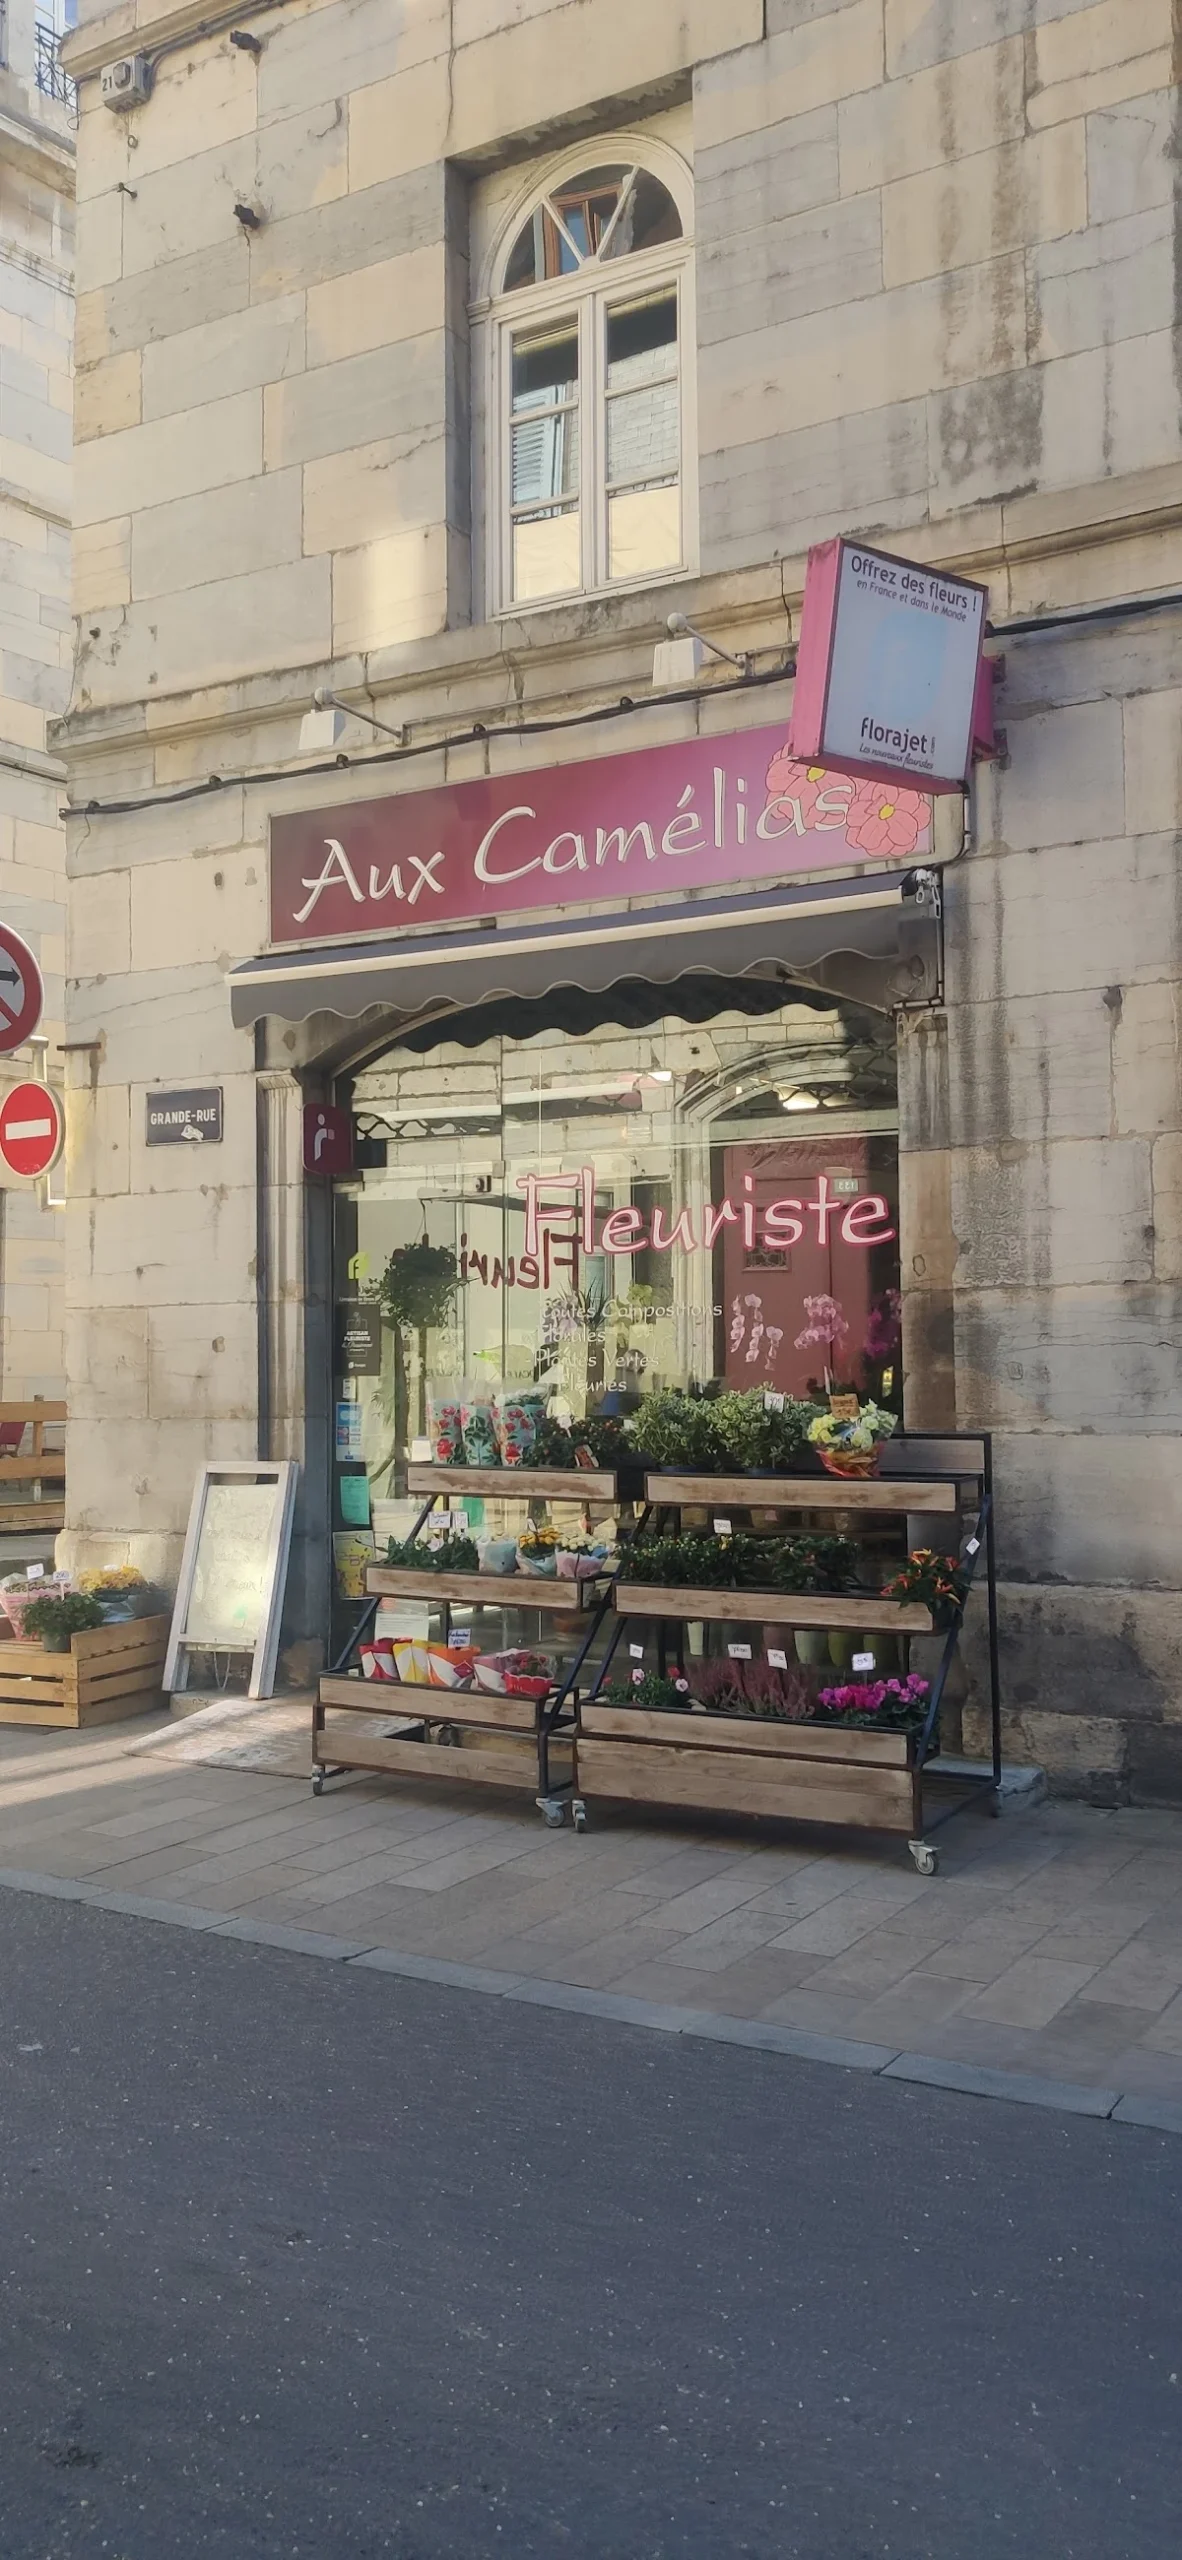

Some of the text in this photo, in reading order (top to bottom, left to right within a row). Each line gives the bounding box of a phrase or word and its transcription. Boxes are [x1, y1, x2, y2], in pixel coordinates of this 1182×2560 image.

[102, 76, 113, 92] 21
[851, 555, 897, 586] Offrez
[901, 573, 925, 595] des
[929, 581, 968, 609] fleurs
[856, 579, 967, 622] en France et dans le Monde
[861, 717, 928, 754] florajet
[293, 766, 857, 923] Aux Camélias
[150, 1108, 217, 1126] GRANDE-RUE
[516, 1165, 896, 1256] Fleuriste
[602, 1300, 723, 1323] Compositions
[603, 1349, 659, 1368] Vertes
